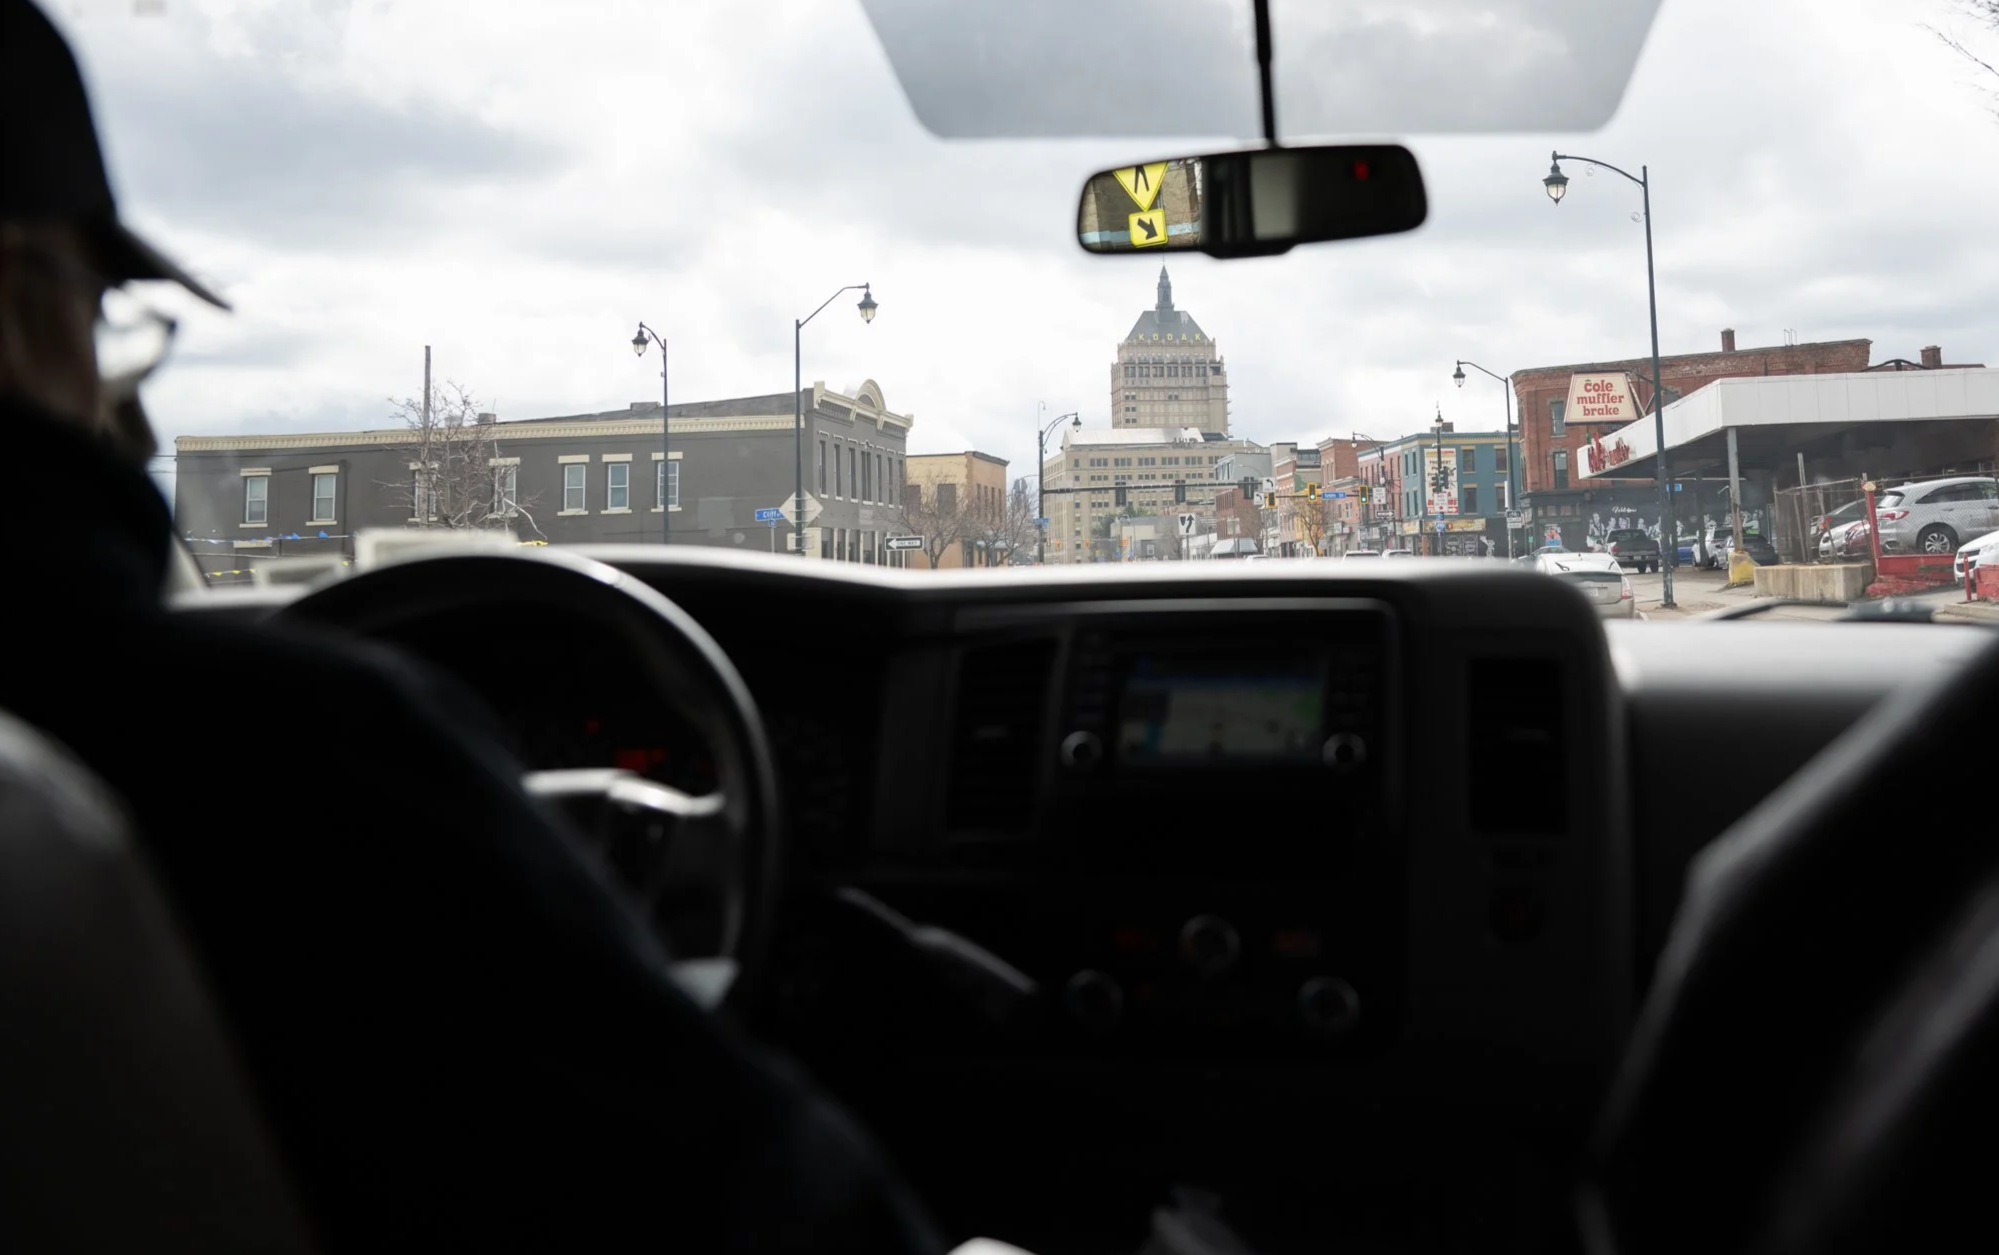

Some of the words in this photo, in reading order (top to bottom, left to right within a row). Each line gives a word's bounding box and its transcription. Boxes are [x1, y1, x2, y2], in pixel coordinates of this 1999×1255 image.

[1138, 333, 1201, 341] KODAK
[1584, 380, 1613, 393] cole
[1576, 393, 1625, 405] muffler
[1583, 405, 1619, 416] brake
